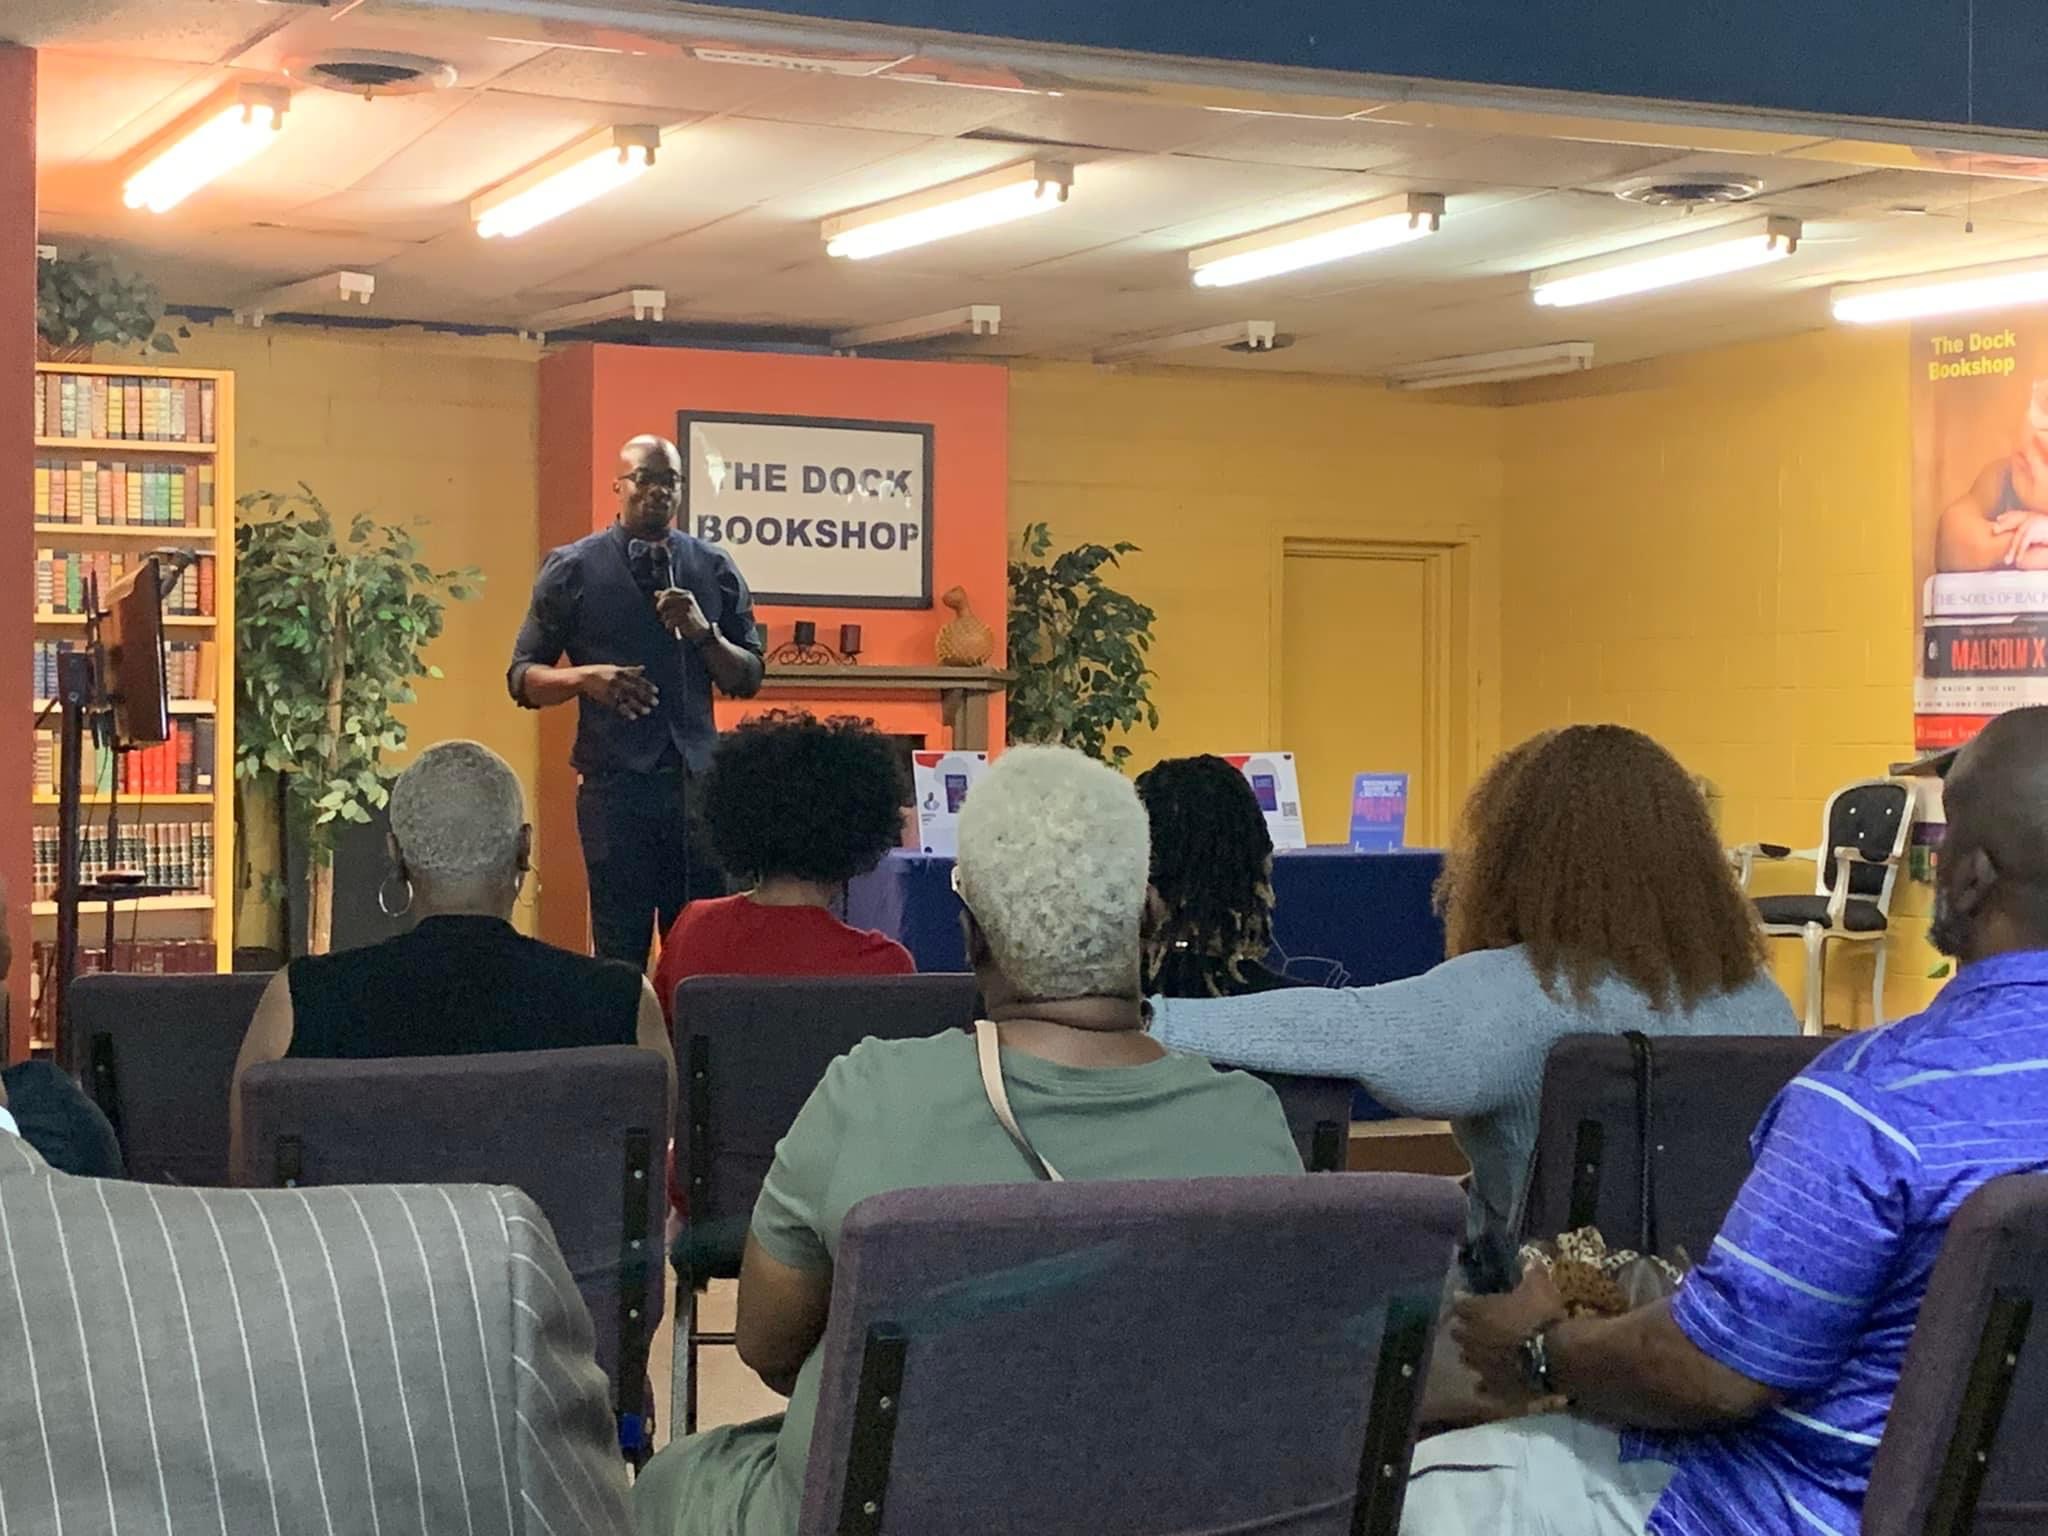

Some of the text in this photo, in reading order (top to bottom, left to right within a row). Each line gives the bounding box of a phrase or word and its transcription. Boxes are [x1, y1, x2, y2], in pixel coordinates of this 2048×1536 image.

[1931, 328, 2016, 355] The Dock
[1928, 355, 2016, 381] Bookshop
[802, 465, 912, 497] DOCK
[697, 514, 919, 550] BOOKSHOP
[1952, 637, 2047, 671] MALCOLM X
